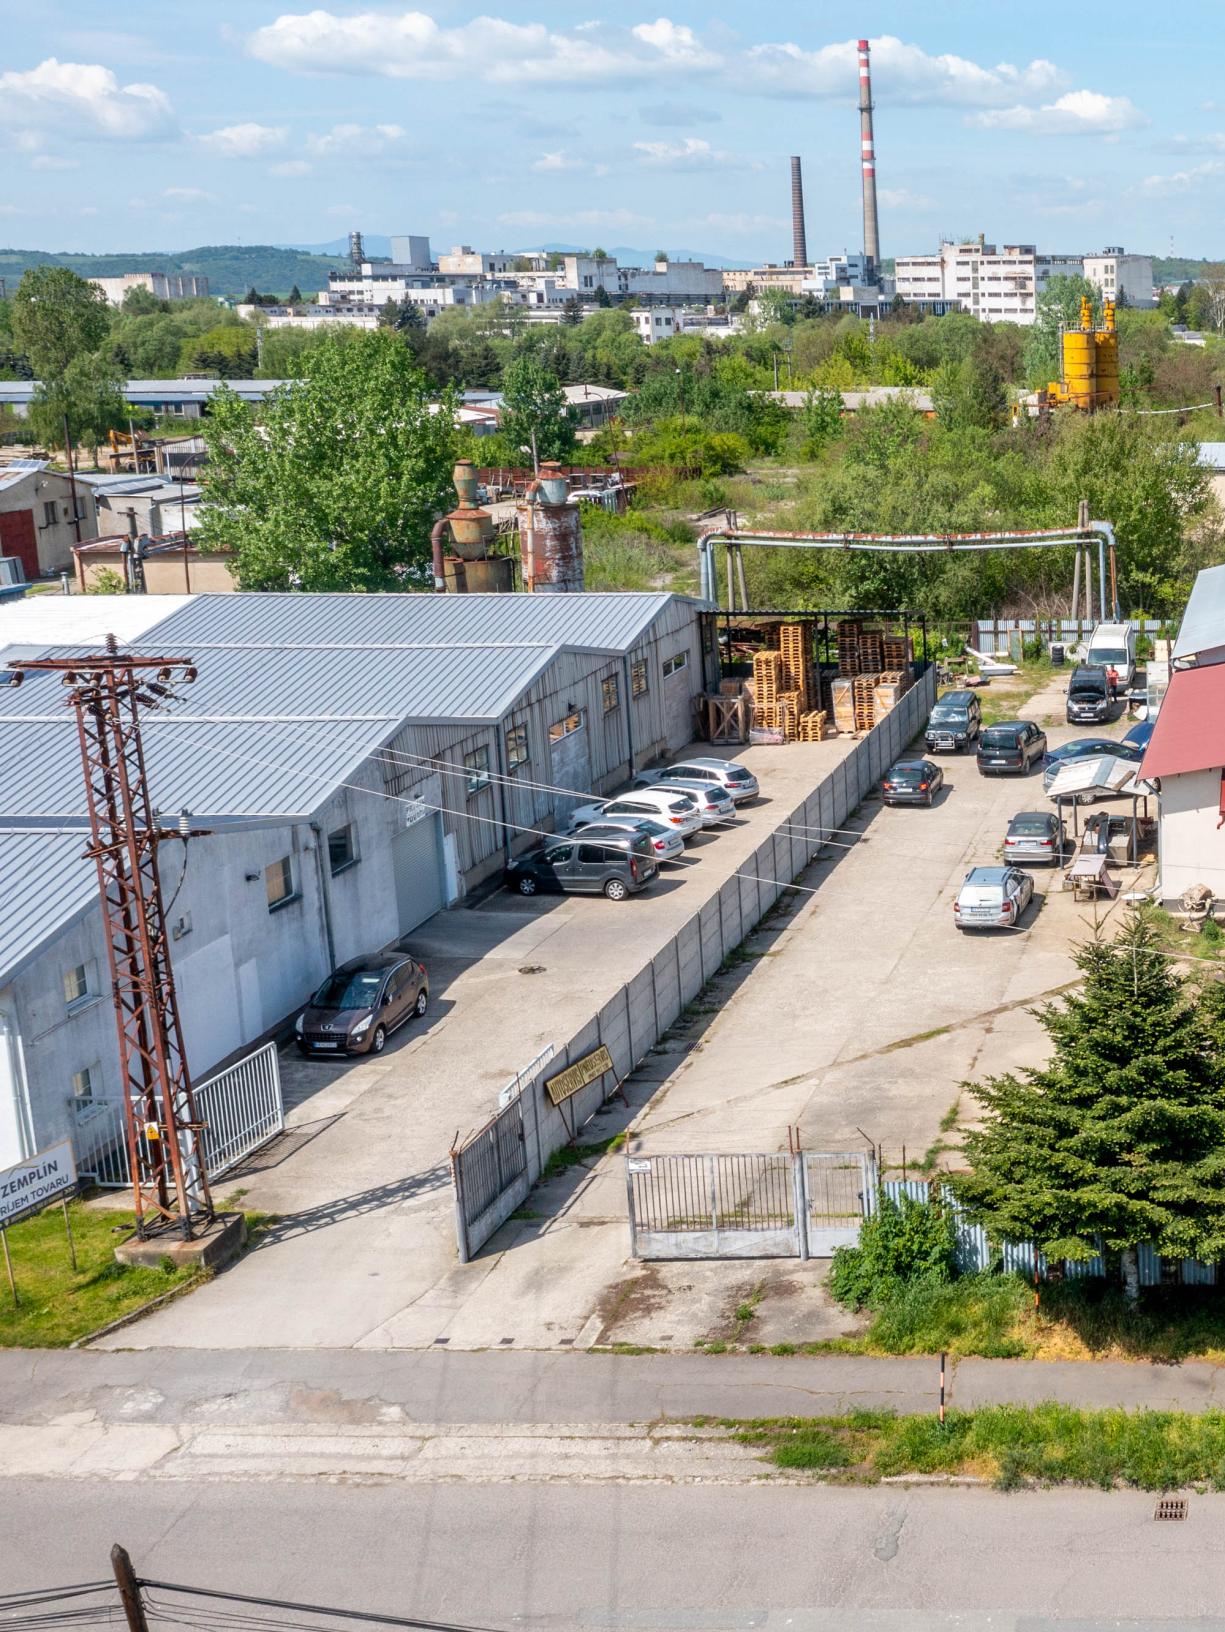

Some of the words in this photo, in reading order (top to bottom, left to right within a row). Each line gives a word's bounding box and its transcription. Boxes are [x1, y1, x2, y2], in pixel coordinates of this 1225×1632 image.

[0, 1160, 59, 1198] ZEMPLÍN
[0, 1195, 29, 1216] RÍJEM
[31, 1175, 69, 1200] TOVARU
